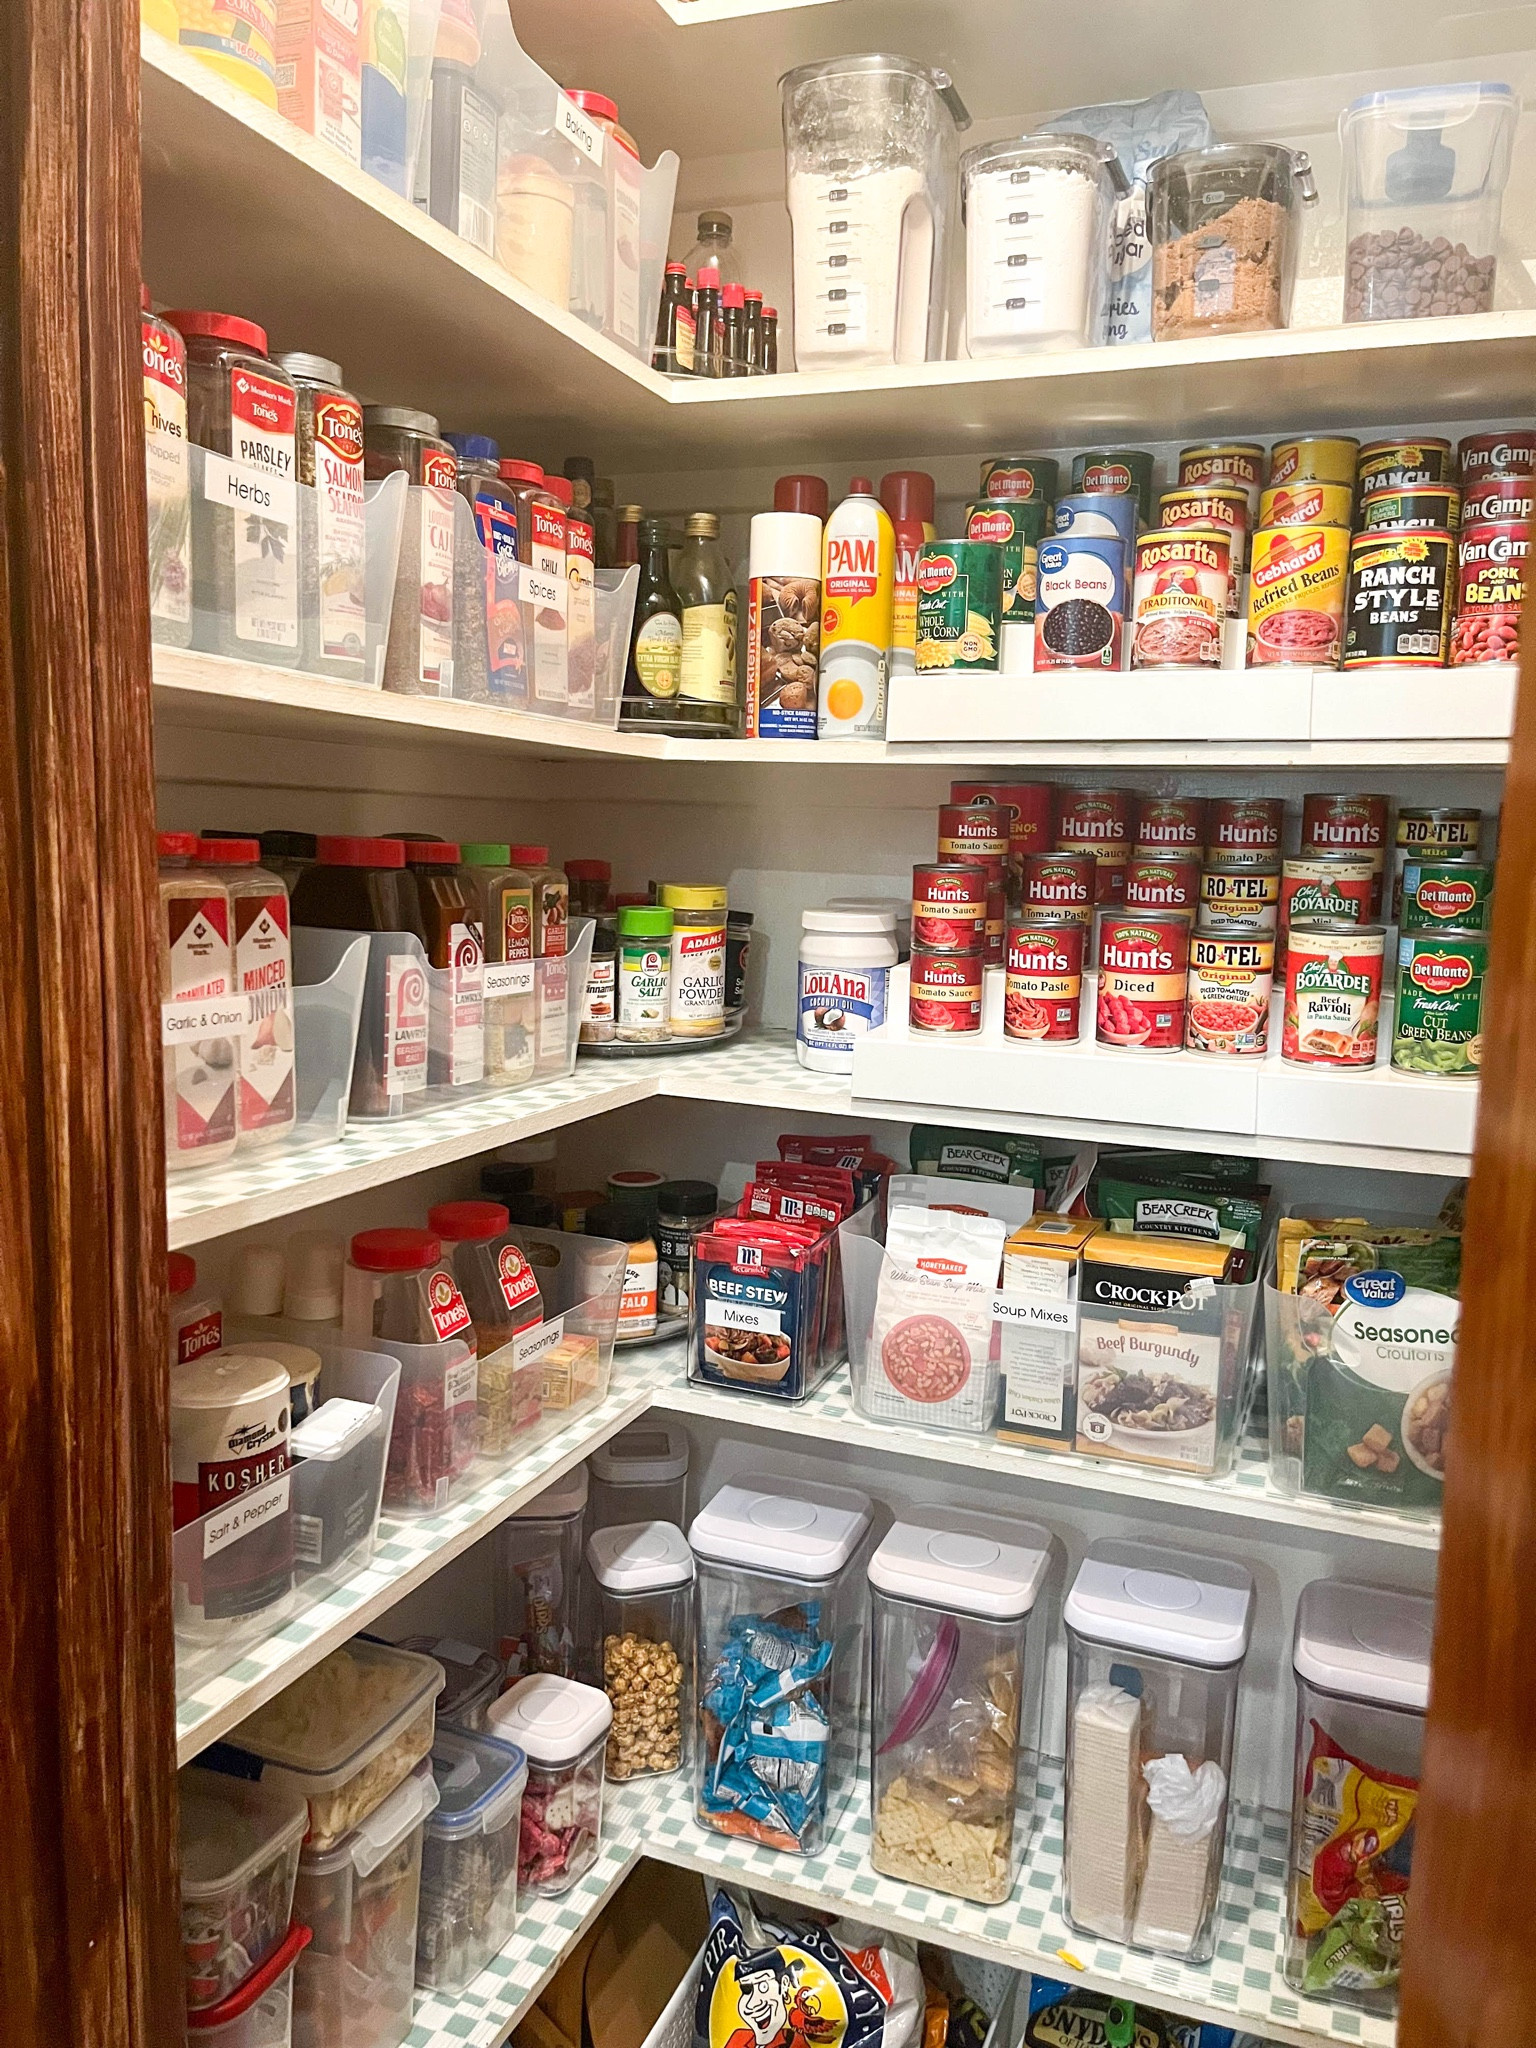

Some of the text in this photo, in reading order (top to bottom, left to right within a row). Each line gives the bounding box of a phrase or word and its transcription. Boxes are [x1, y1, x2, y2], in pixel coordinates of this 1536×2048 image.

[565, 112, 592, 151] Baking
[142, 342, 182, 385] one's
[252, 403, 278, 422] Tone's
[324, 417, 362, 448] Tone's
[241, 440, 292, 472] PARSLEY
[324, 458, 362, 492] SALMON
[1184, 455, 1254, 485] Rosarita
[989, 478, 1031, 491] Del Monte
[1085, 474, 1128, 486] Del Monte
[1364, 472, 1430, 494] RANCH
[228, 475, 270, 507] Herbs
[1161, 498, 1234, 529] Rosarita
[534, 514, 563, 540] Tone's
[970, 521, 1011, 534] Del Monte
[568, 531, 592, 554] Tone's
[827, 540, 875, 574] PAM
[1041, 553, 1063, 565] Great
[1140, 541, 1218, 573] Rosarita
[1255, 542, 1323, 586] Gebhardt
[1044, 560, 1064, 569] Value
[927, 566, 953, 578] Monte
[1360, 567, 1435, 588] RANCH
[1478, 566, 1520, 583] PORK
[529, 579, 556, 601] Spices
[830, 580, 870, 588] ORIGINAL
[1046, 578, 1107, 592] Black Beans
[1253, 564, 1340, 614] Refried Beans
[942, 590, 964, 598] WITH
[1276, 587, 1320, 608] STYLE FRIJOLES
[1353, 588, 1440, 613] STYLE
[1144, 596, 1208, 610] TRADITIONAL
[1472, 604, 1504, 614] TOMATO
[920, 616, 944, 628] WHOLE
[1370, 611, 1419, 625] BEANS
[933, 626, 959, 637] CORN
[1343, 805, 1371, 817] NATURAL
[951, 841, 1004, 850] Tomato Sauce
[1055, 867, 1077, 876] NATURAL
[1150, 868, 1174, 878] NATURAL
[1296, 886, 1319, 898] Chef
[1420, 890, 1472, 903] Del Monte
[920, 905, 977, 915] Tomato Sauce
[1211, 903, 1260, 913] Original
[1290, 897, 1360, 916] BOYARDEE
[1064, 910, 1088, 920] Paste
[1458, 916, 1481, 924] WITH
[1226, 918, 1258, 927] TOMATOES
[508, 937, 530, 948] LEMON
[686, 934, 722, 950] ADAMS
[1018, 935, 1055, 945] 100% NATURAL
[1115, 929, 1159, 942] 100% NATURAL
[508, 948, 529, 958] PEPPER
[545, 961, 566, 976] Tone's
[1302, 961, 1325, 974] Chef
[1414, 964, 1469, 978] Del Monte
[244, 959, 285, 992] MINCED
[486, 973, 530, 989] Seasonings
[631, 976, 668, 987] GARLIC
[684, 976, 723, 987] GARLIC
[1201, 971, 1251, 981] Original
[1295, 972, 1370, 993] BOYARDEE
[1427, 978, 1451, 987] Quality
[805, 974, 865, 1000] LouAna
[1006, 976, 1070, 992] Tomato Paste
[1114, 979, 1155, 993] Diced
[638, 987, 663, 998] SALT
[918, 987, 973, 998] Tomato Sauce
[1200, 986, 1250, 997] DICED TOMATOES
[1226, 993, 1247, 1002] CHILIES
[1453, 993, 1479, 1001] WITH
[810, 997, 854, 1010] COCONUT OIL
[1320, 995, 1341, 1004] Beef
[1413, 998, 1437, 1010] Fresh
[1308, 1001, 1351, 1015] Ravioli
[166, 1011, 242, 1031] Garlic & Onion
[1422, 1016, 1449, 1029] CUT
[1401, 1023, 1472, 1042] GREEN BEANS
[946, 1147, 1006, 1167] BEAR CREEK
[1142, 1203, 1178, 1217] BEAR
[1174, 1203, 1214, 1220] CREEK
[1174, 1225, 1212, 1236] KITCHENS
[732, 1265, 767, 1275] McCormick
[920, 1261, 963, 1272] HONEYBAKED
[504, 1274, 534, 1300] Tone's
[1352, 1277, 1396, 1291] Great
[709, 1278, 788, 1305] BEEF STEW
[1362, 1288, 1395, 1300] Value
[434, 1303, 466, 1330] Tone's
[724, 1308, 759, 1326] Mixes
[992, 1301, 1069, 1323] Soup Mixes
[182, 1325, 220, 1358] Tone's
[519, 1330, 560, 1361] Seasonings
[1096, 1336, 1200, 1368] Beef Burgundy
[1376, 1345, 1445, 1363] Croutons
[1094, 1423, 1101, 1433] 8
[228, 1424, 267, 1449] Diamond
[208, 1454, 285, 1492] KOSHER
[209, 1492, 283, 1545] Salt & Pepper
[862, 1950, 881, 1982] 18 oz
[802, 1930, 881, 2022] BOOTY
